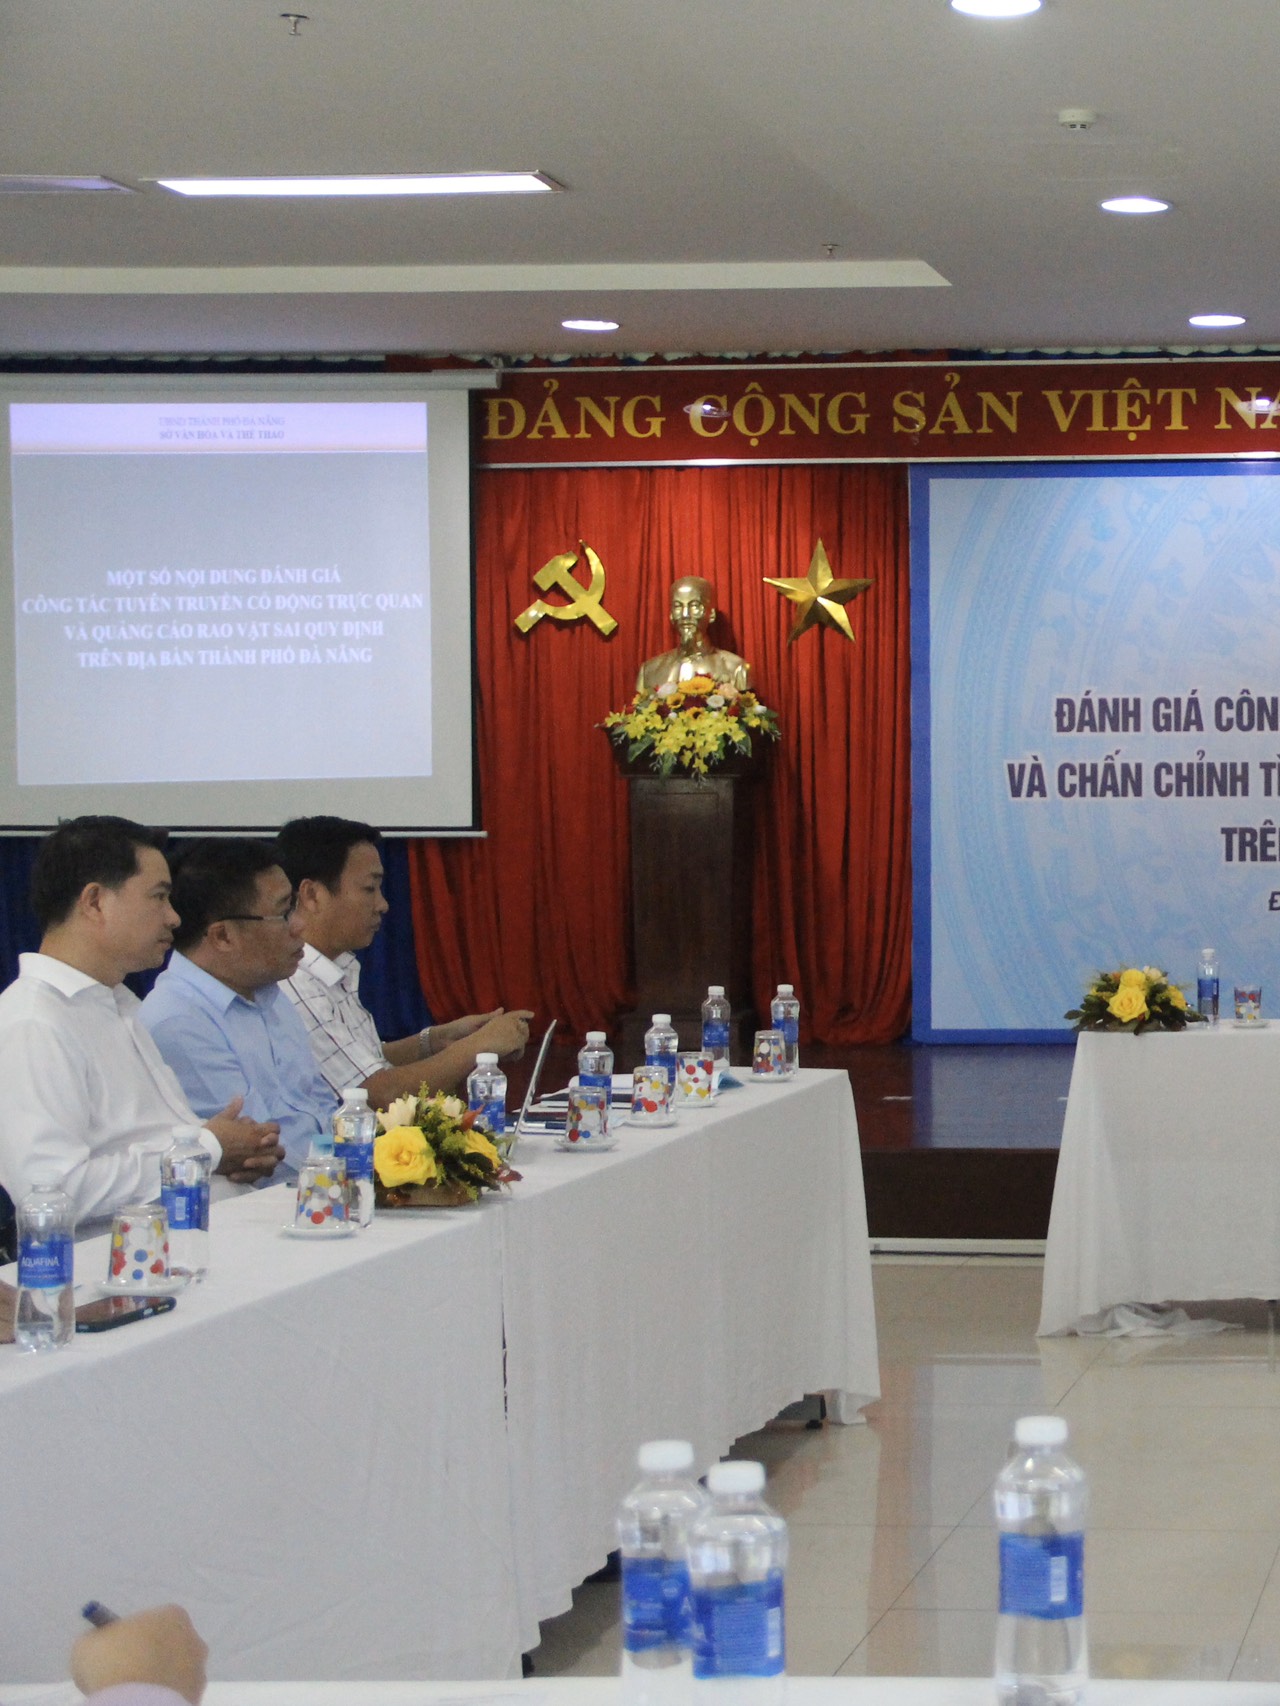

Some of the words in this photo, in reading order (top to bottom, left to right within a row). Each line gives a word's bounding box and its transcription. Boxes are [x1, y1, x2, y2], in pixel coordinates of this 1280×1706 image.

[484, 379, 666, 440] ĐẢNG
[688, 382, 871, 447] CỘNG
[892, 371, 1019, 435] SẢN
[1042, 378, 1198, 441] VIỆT
[107, 569, 147, 589] MỘT
[176, 568, 206, 588] NỘI
[209, 569, 257, 585] DUNG
[311, 564, 342, 583] GIÁ
[22, 594, 72, 614] CÔNG
[76, 594, 111, 613] TÁC
[375, 593, 424, 611] QUAN
[64, 621, 88, 641] VÀ
[156, 619, 193, 639] CÁO
[197, 622, 233, 639] RAO
[273, 622, 300, 638] SAI
[304, 622, 340, 640] QUY
[78, 647, 124, 667] TRÊN
[1055, 690, 1141, 733] ĐÁNH
[1153, 689, 1202, 732] GIÁ
[1006, 755, 1047, 798] VÀ
[1057, 748, 1143, 798] CHẤN
[1153, 749, 1250, 798] CHỈNH
